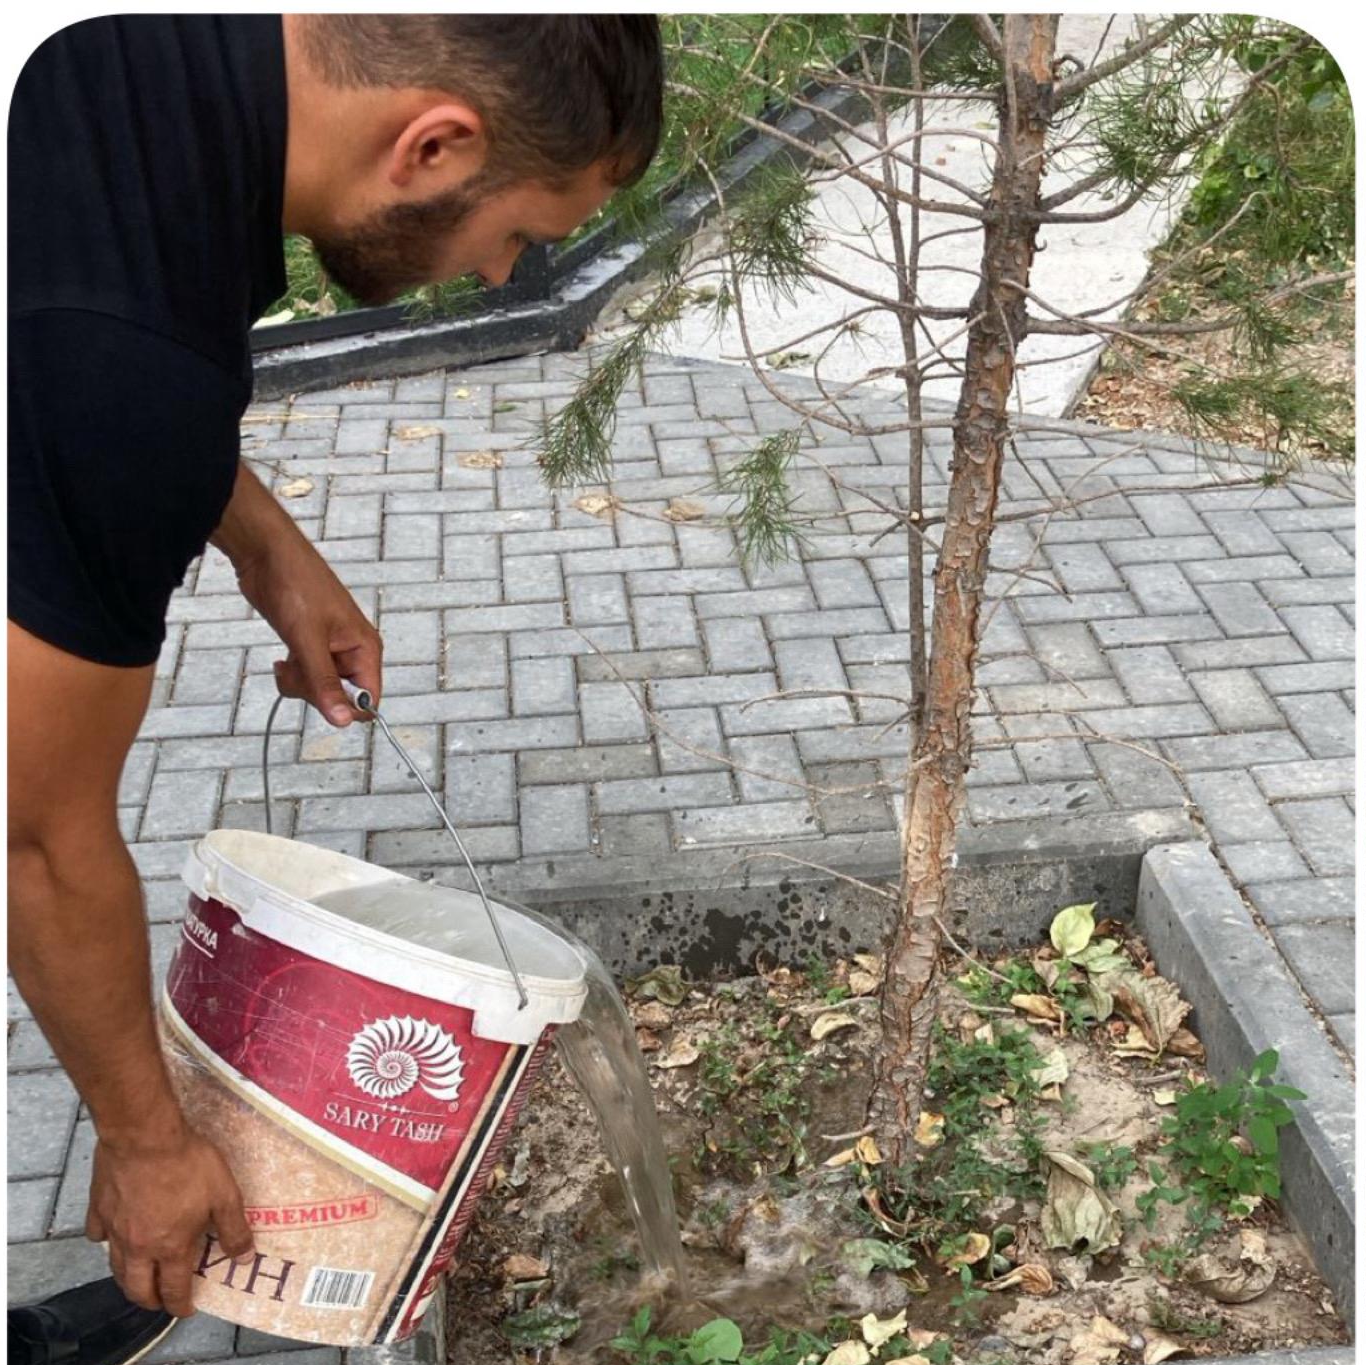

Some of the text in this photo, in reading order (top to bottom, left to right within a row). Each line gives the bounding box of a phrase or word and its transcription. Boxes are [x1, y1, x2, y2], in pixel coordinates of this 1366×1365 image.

[323, 1101, 444, 1142] SARY TASH
[246, 1199, 368, 1226] PREMIUM
